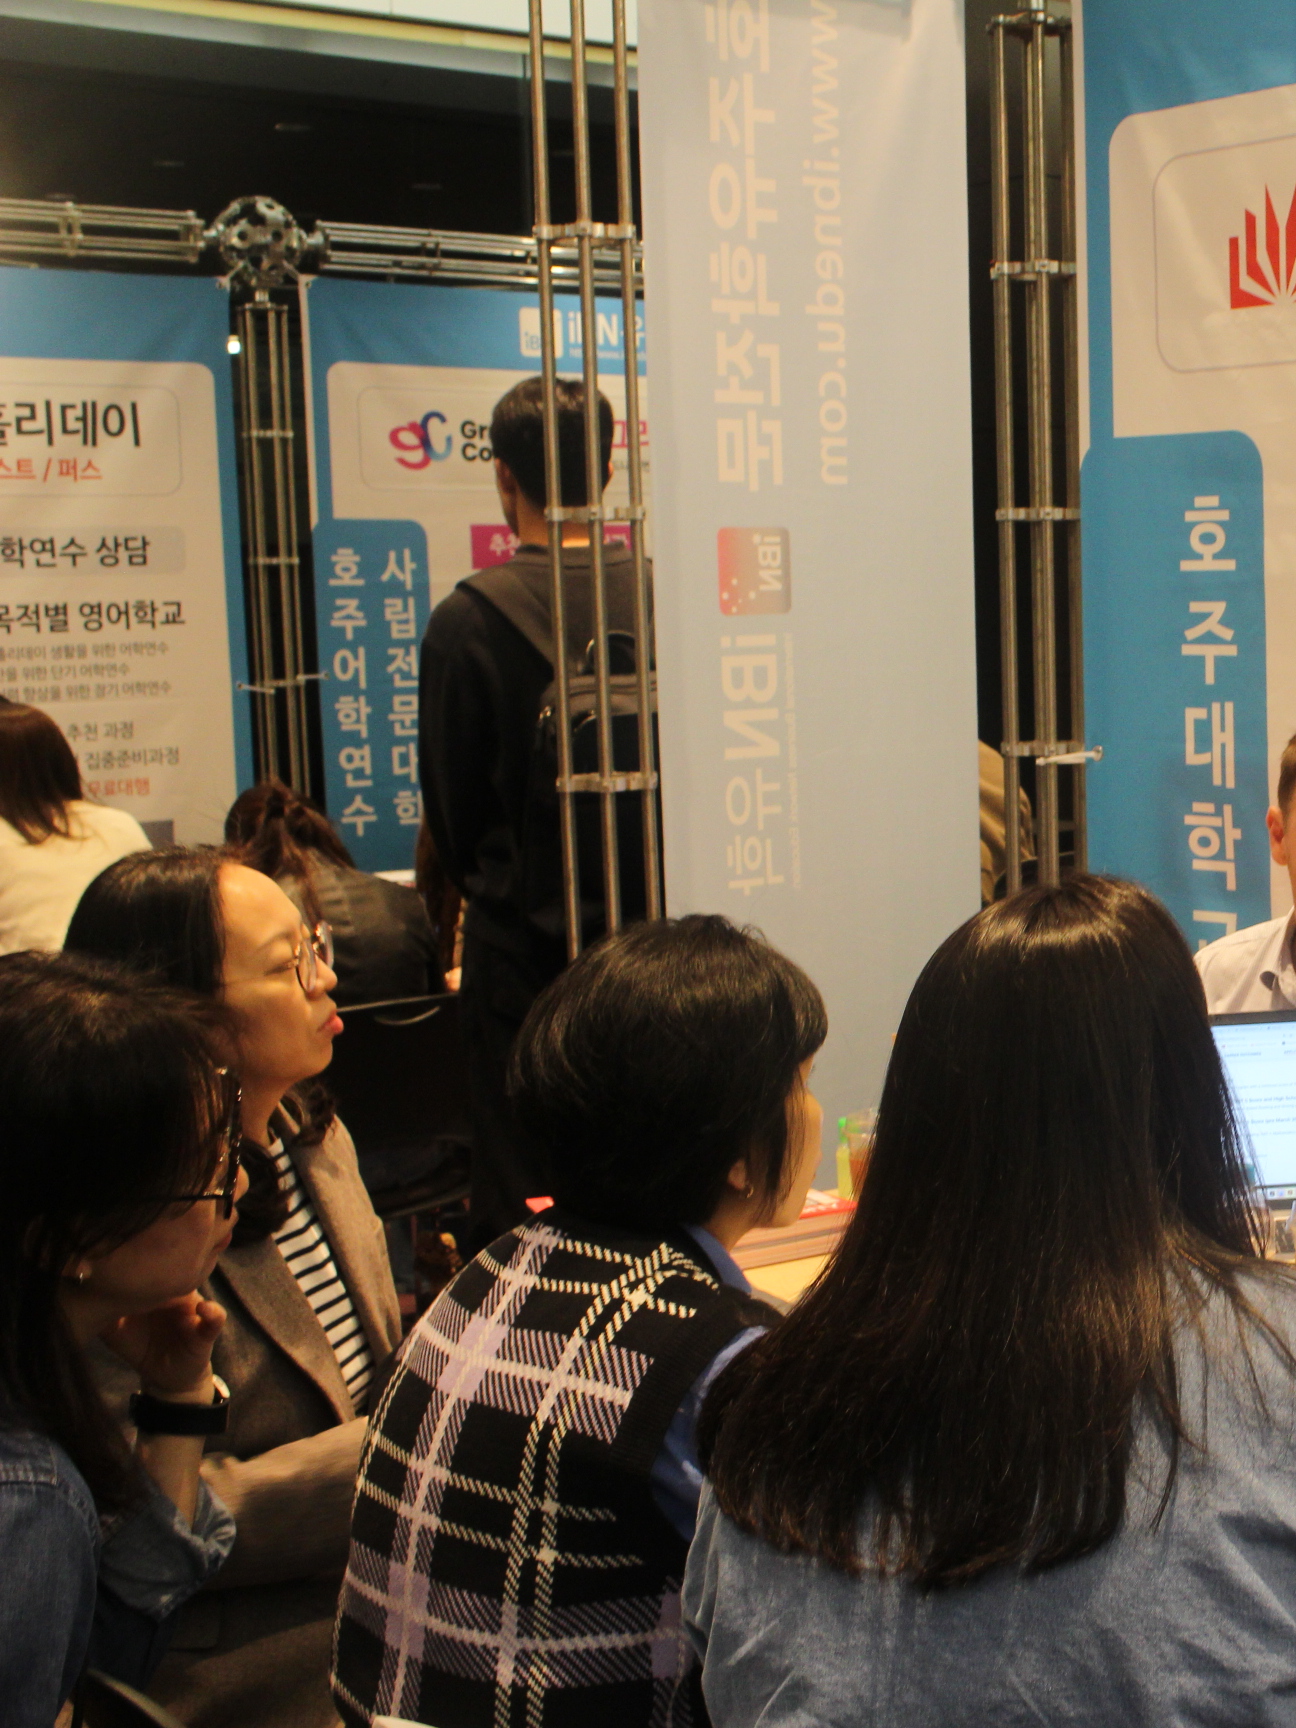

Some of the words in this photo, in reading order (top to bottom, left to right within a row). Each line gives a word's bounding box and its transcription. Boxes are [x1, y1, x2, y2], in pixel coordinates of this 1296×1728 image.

[58, 458, 103, 482] 퍼스
[96, 535, 150, 568] 상담
[79, 600, 186, 633] 영어학교
